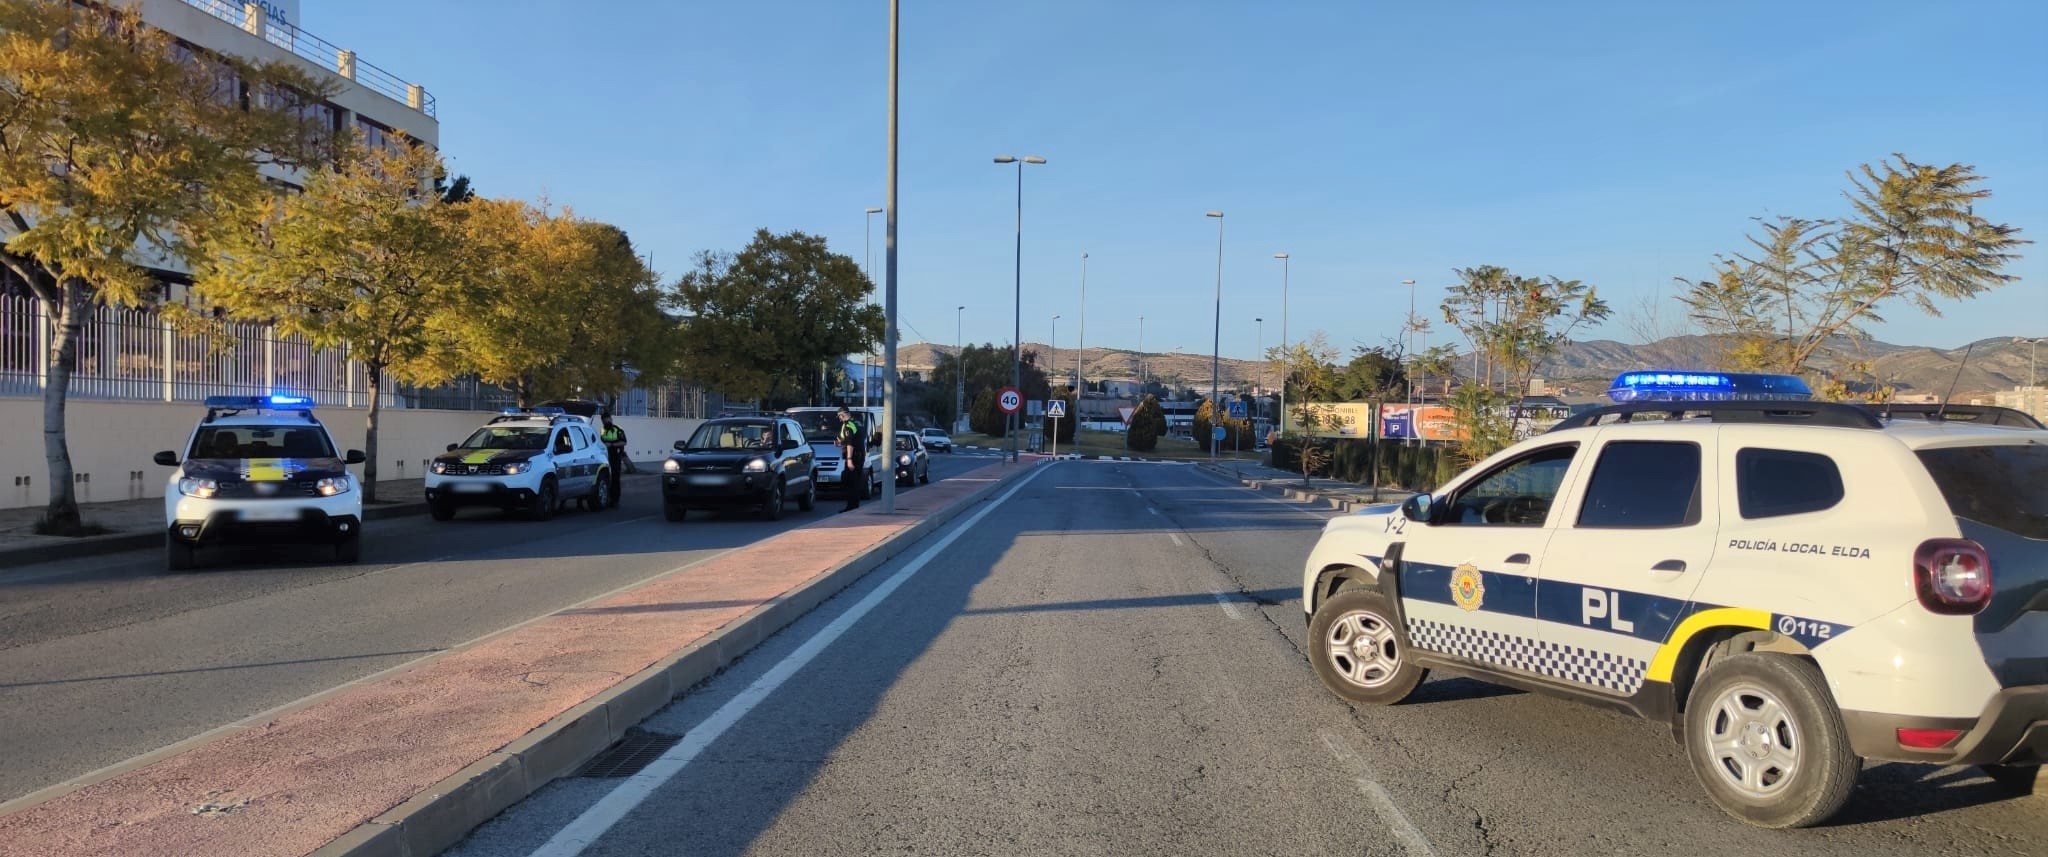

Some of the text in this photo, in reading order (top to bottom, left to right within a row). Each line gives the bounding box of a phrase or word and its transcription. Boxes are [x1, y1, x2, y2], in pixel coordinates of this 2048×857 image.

[1002, 396, 1018, 406] 40
[1392, 424, 1399, 433] P
[1384, 516, 1407, 535] Y-2
[1728, 538, 1870, 559] POLICÍA LOCAL ELDA
[1582, 586, 1634, 633] PL
[1797, 620, 1831, 639] 112
